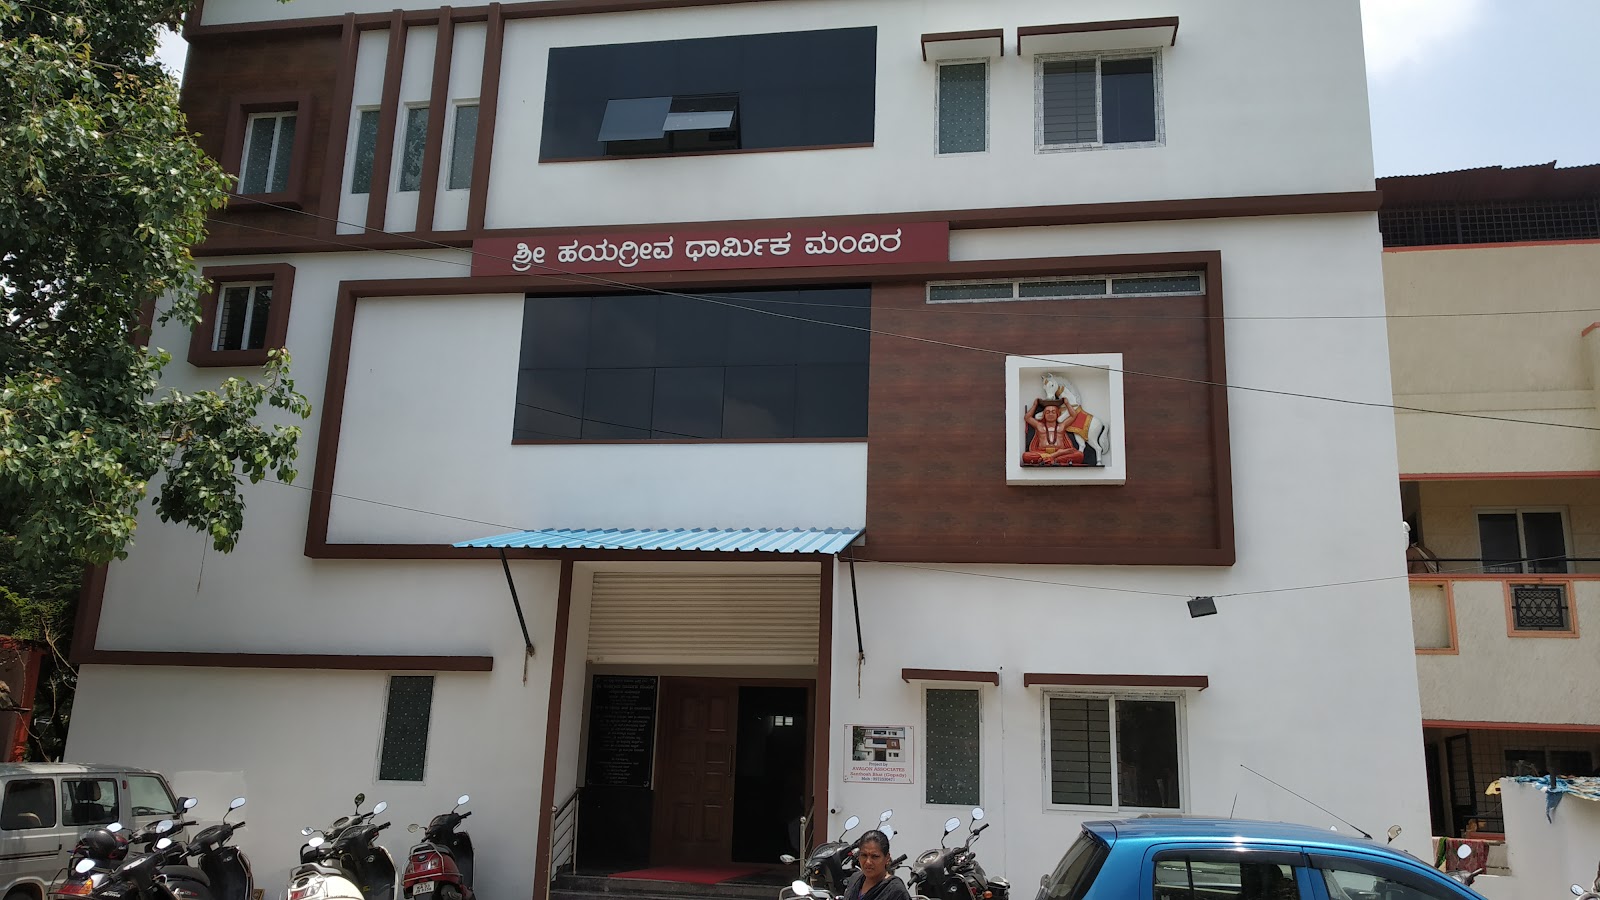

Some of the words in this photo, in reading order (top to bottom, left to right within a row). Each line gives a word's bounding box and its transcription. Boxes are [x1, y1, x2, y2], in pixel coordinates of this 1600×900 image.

[511, 242, 547, 273] ಶ್ರೀ
[557, 235, 675, 268] ಹಯಗ್ರೀವ
[684, 231, 792, 263] ಧಾರ್ಮಿಕ
[804, 227, 903, 256] ಮಂದಿರ
